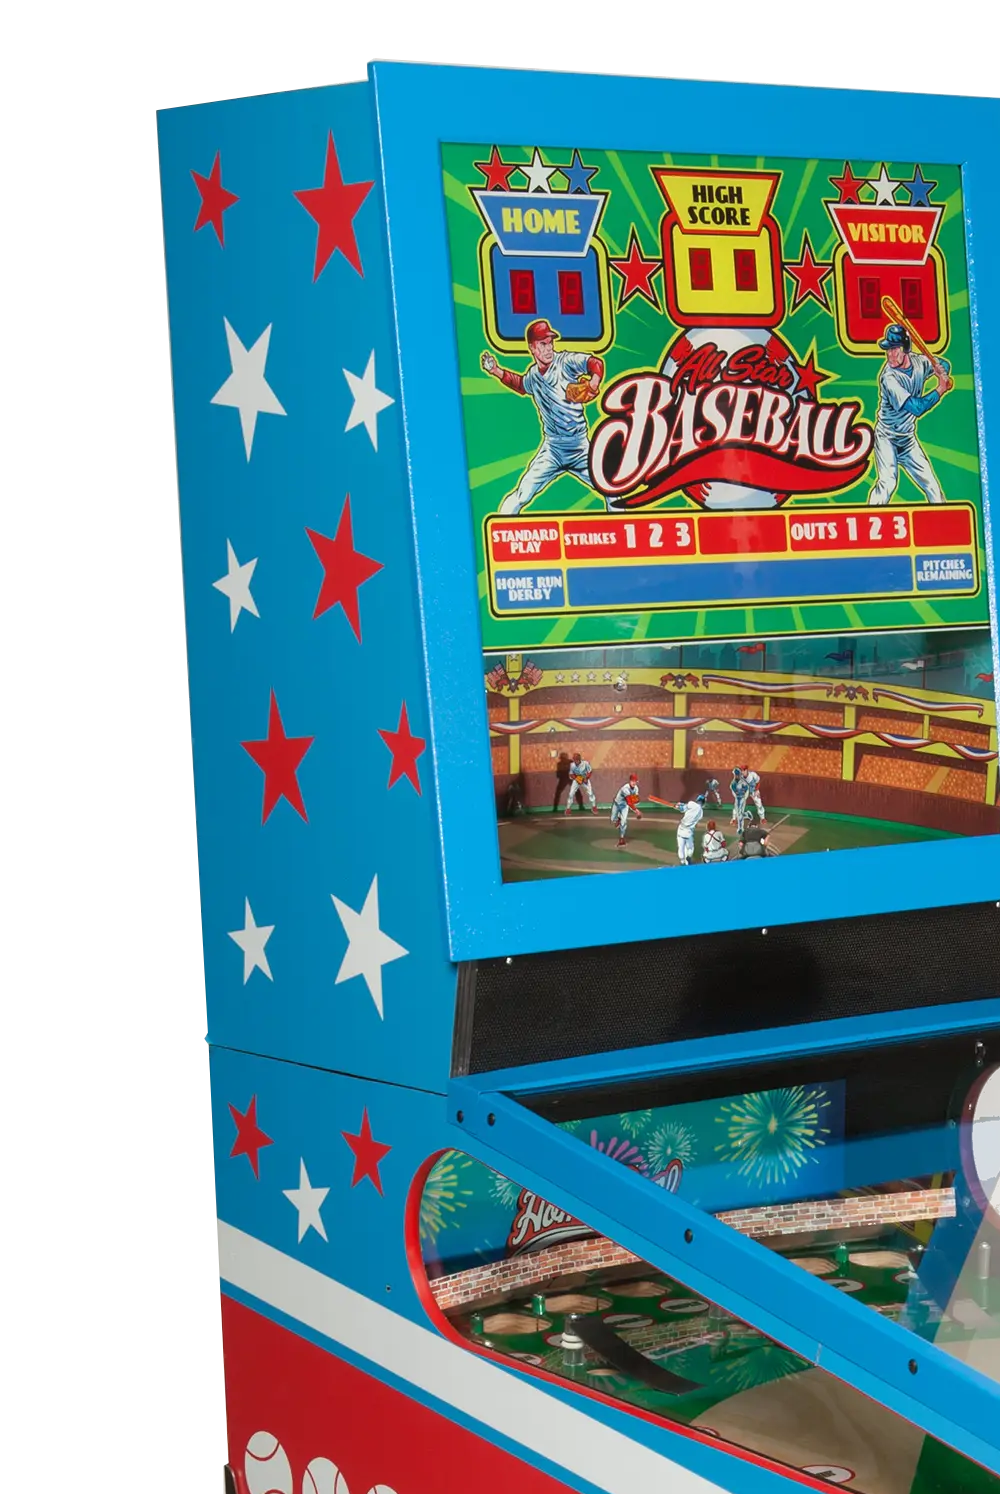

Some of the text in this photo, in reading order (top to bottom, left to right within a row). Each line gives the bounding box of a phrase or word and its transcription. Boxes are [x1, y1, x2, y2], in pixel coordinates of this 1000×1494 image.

[691, 184, 743, 205] HIGH
[501, 207, 582, 235] HOME
[687, 205, 751, 226] SCORE
[846, 222, 927, 244] VISITOR
[590, 374, 873, 495] BASEBALL
[492, 528, 559, 543] STANDARD
[563, 522, 692, 549] STRIKES 1 2 3
[790, 516, 908, 541] OUTS 1 2 3
[510, 541, 542, 554] PLAY
[917, 569, 973, 582] REMAINING
[922, 559, 966, 571] PITCHES
[496, 576, 563, 590] HOME RUN
[508, 588, 552, 602] DERBY
